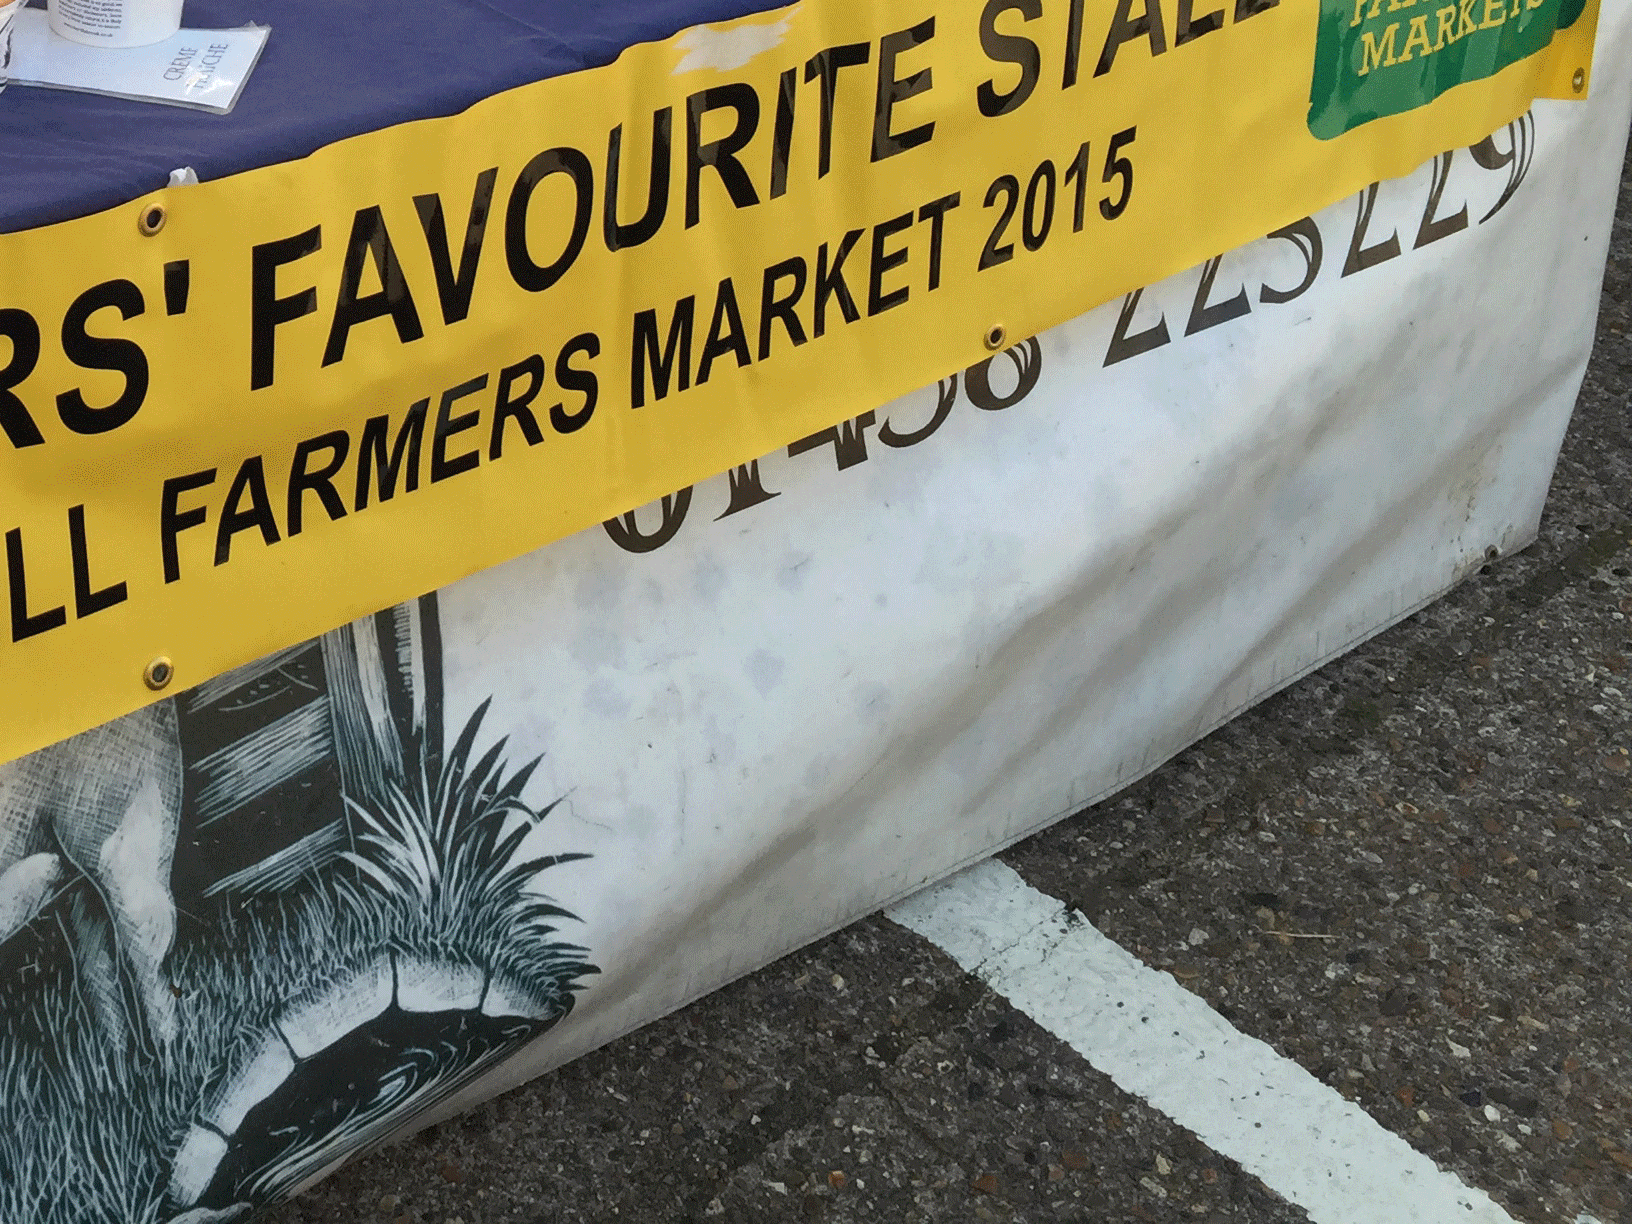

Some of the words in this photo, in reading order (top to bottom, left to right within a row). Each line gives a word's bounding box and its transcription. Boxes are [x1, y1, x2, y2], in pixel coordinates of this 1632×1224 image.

[161, 331, 600, 585] FARMERS
[630, 190, 962, 410] MARKET
[979, 125, 1138, 274] 2015
[251, 15, 937, 391] FAVOURITE
